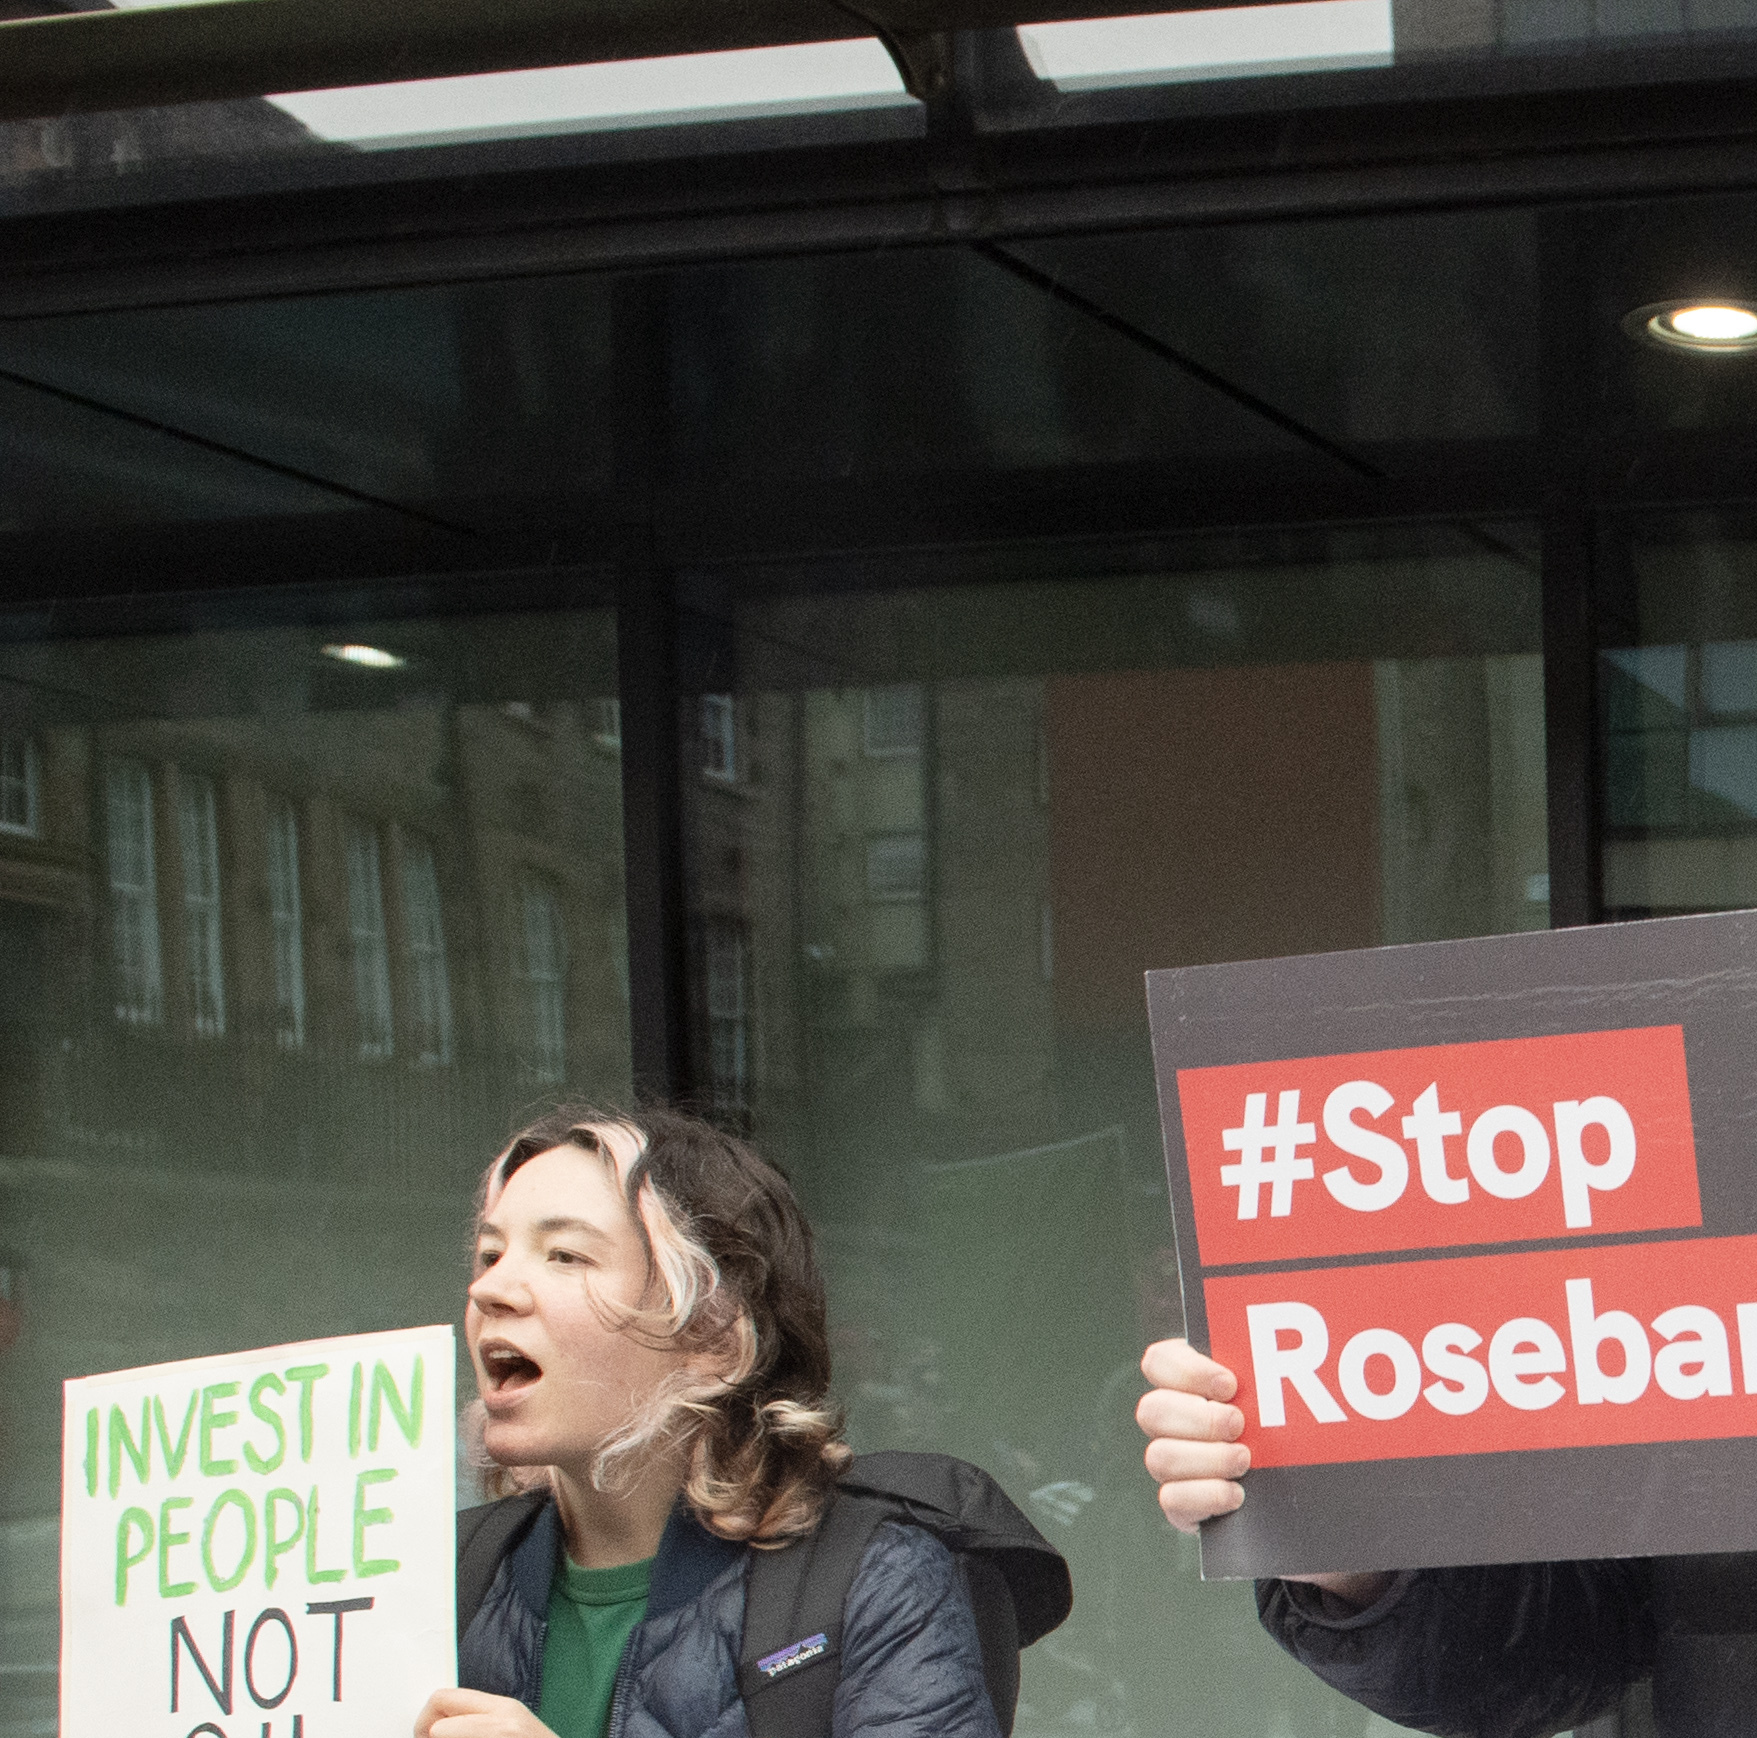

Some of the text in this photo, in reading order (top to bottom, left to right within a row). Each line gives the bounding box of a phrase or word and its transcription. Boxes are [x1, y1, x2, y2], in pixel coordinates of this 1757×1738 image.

[1221, 1080, 1637, 1228] #Stop
[83, 1355, 426, 1500] INVEST IN
[114, 1467, 402, 1608] PEOPLE
[170, 1596, 376, 1716] NOT
[767, 1645, 825, 1678] patagonia
